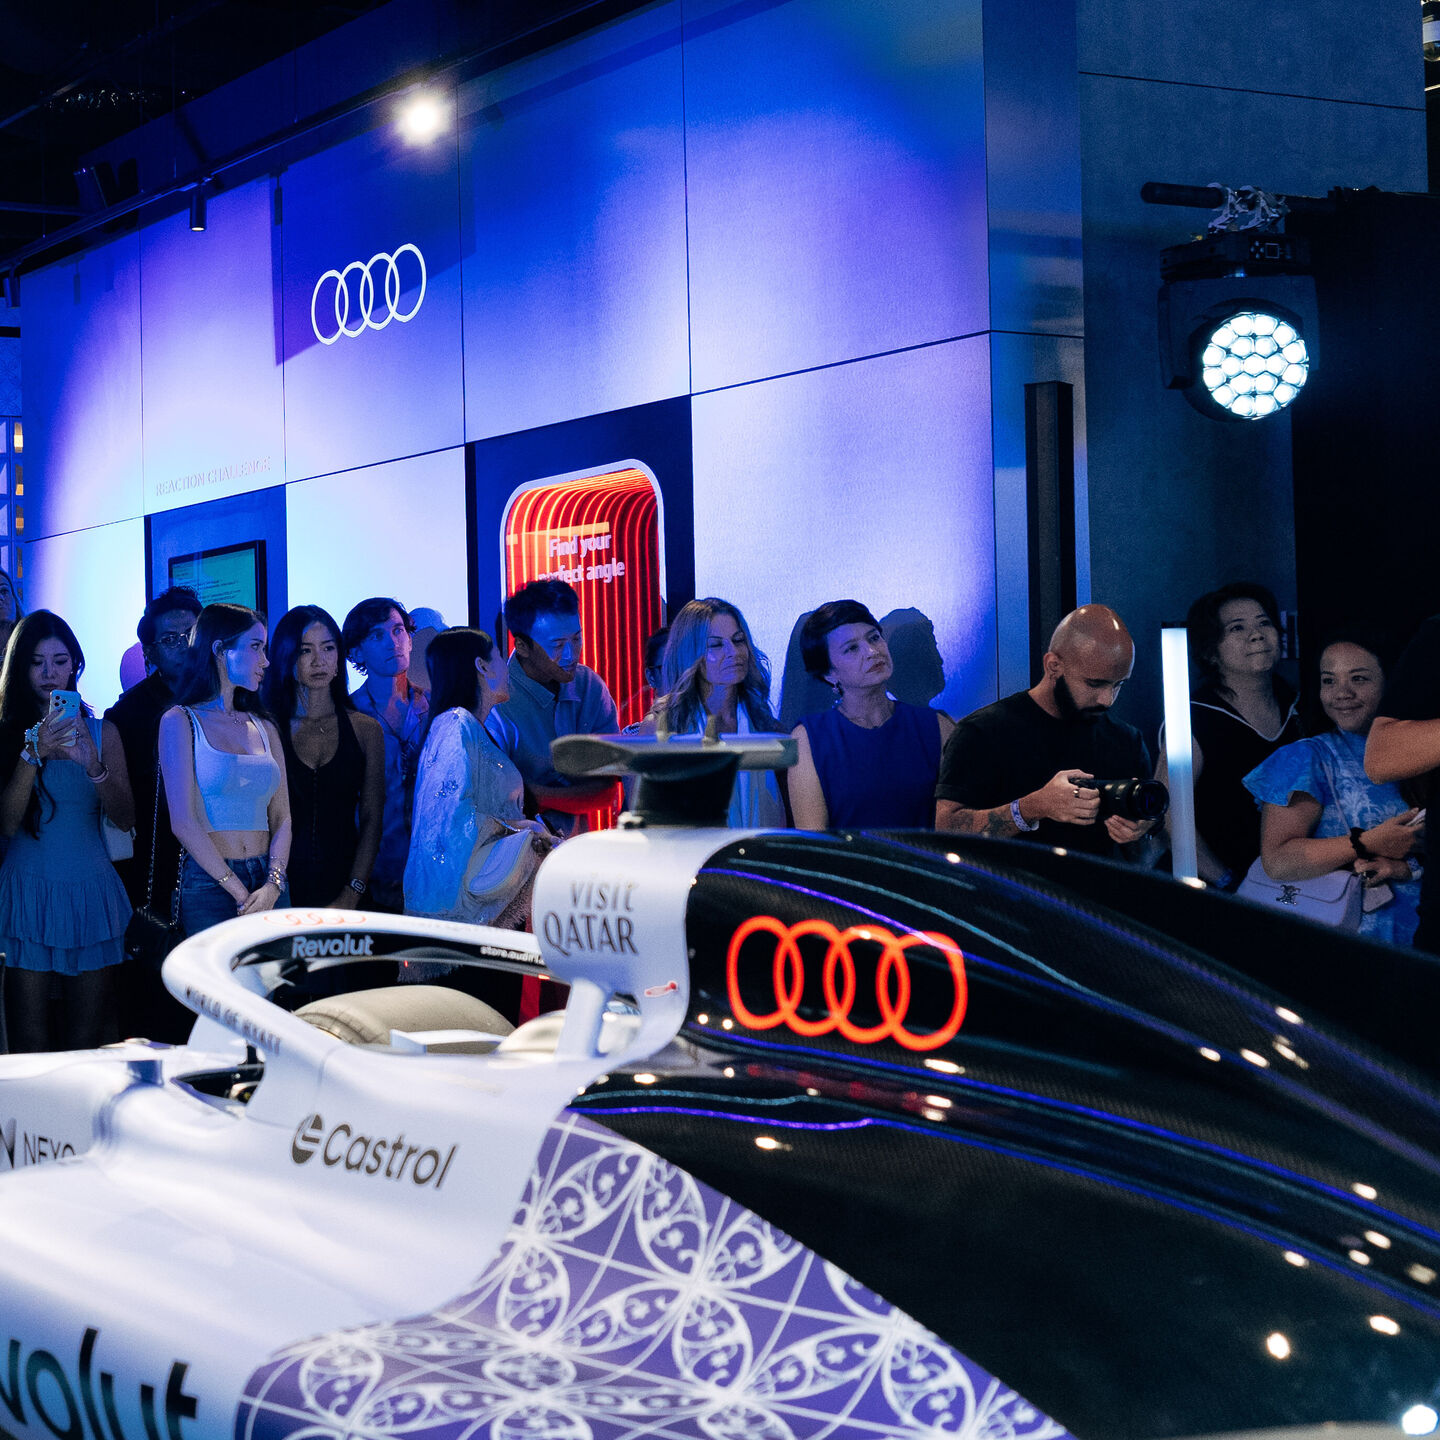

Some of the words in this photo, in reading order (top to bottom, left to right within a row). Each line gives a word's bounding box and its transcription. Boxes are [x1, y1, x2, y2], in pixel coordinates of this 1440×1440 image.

[156, 472, 205, 496] REACTION
[207, 456, 271, 483] CHALLENGE
[549, 535, 578, 558] Find
[579, 534, 612, 558] your
[586, 557, 626, 584] angle
[291, 933, 374, 958] Revolut
[544, 911, 639, 957] QATAR
[323, 1123, 457, 1189] Castrol
